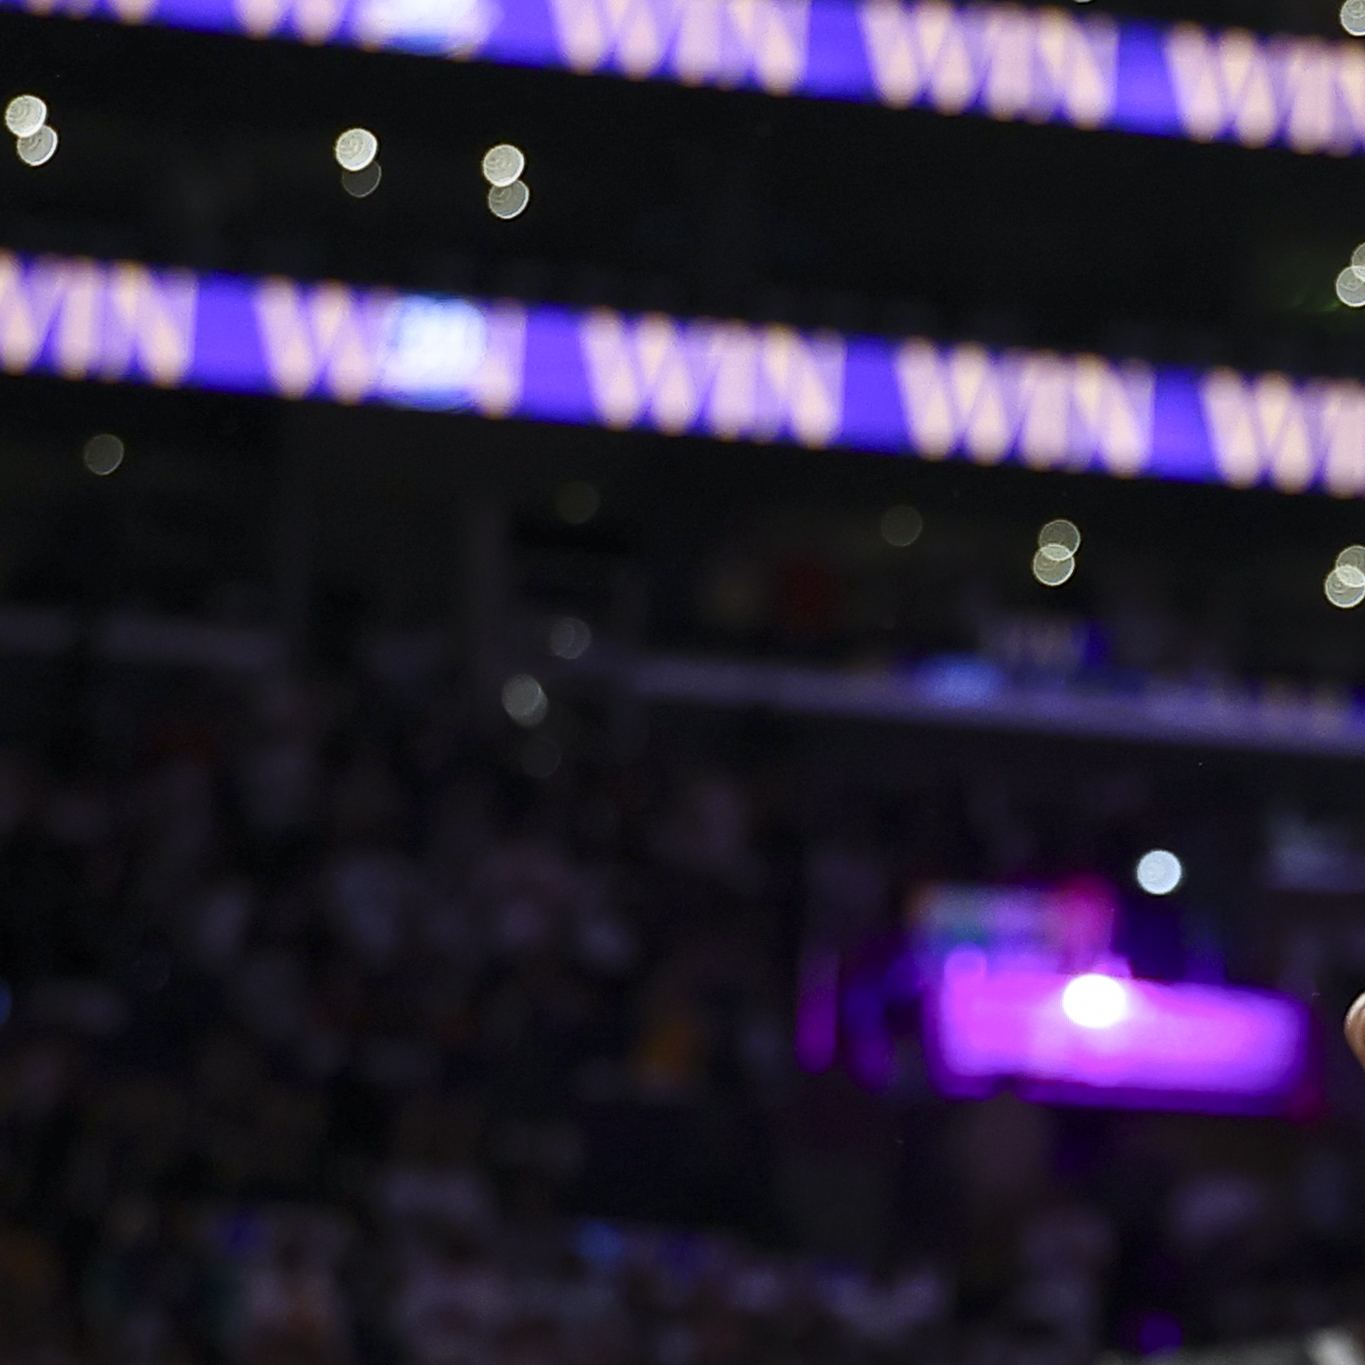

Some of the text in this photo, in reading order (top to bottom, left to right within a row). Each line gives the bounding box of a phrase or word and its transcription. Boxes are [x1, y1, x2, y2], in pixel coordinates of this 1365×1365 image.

[858, 0, 1118, 130] WIN
[580, 306, 845, 450] WIN
[893, 336, 1155, 480] WIN
